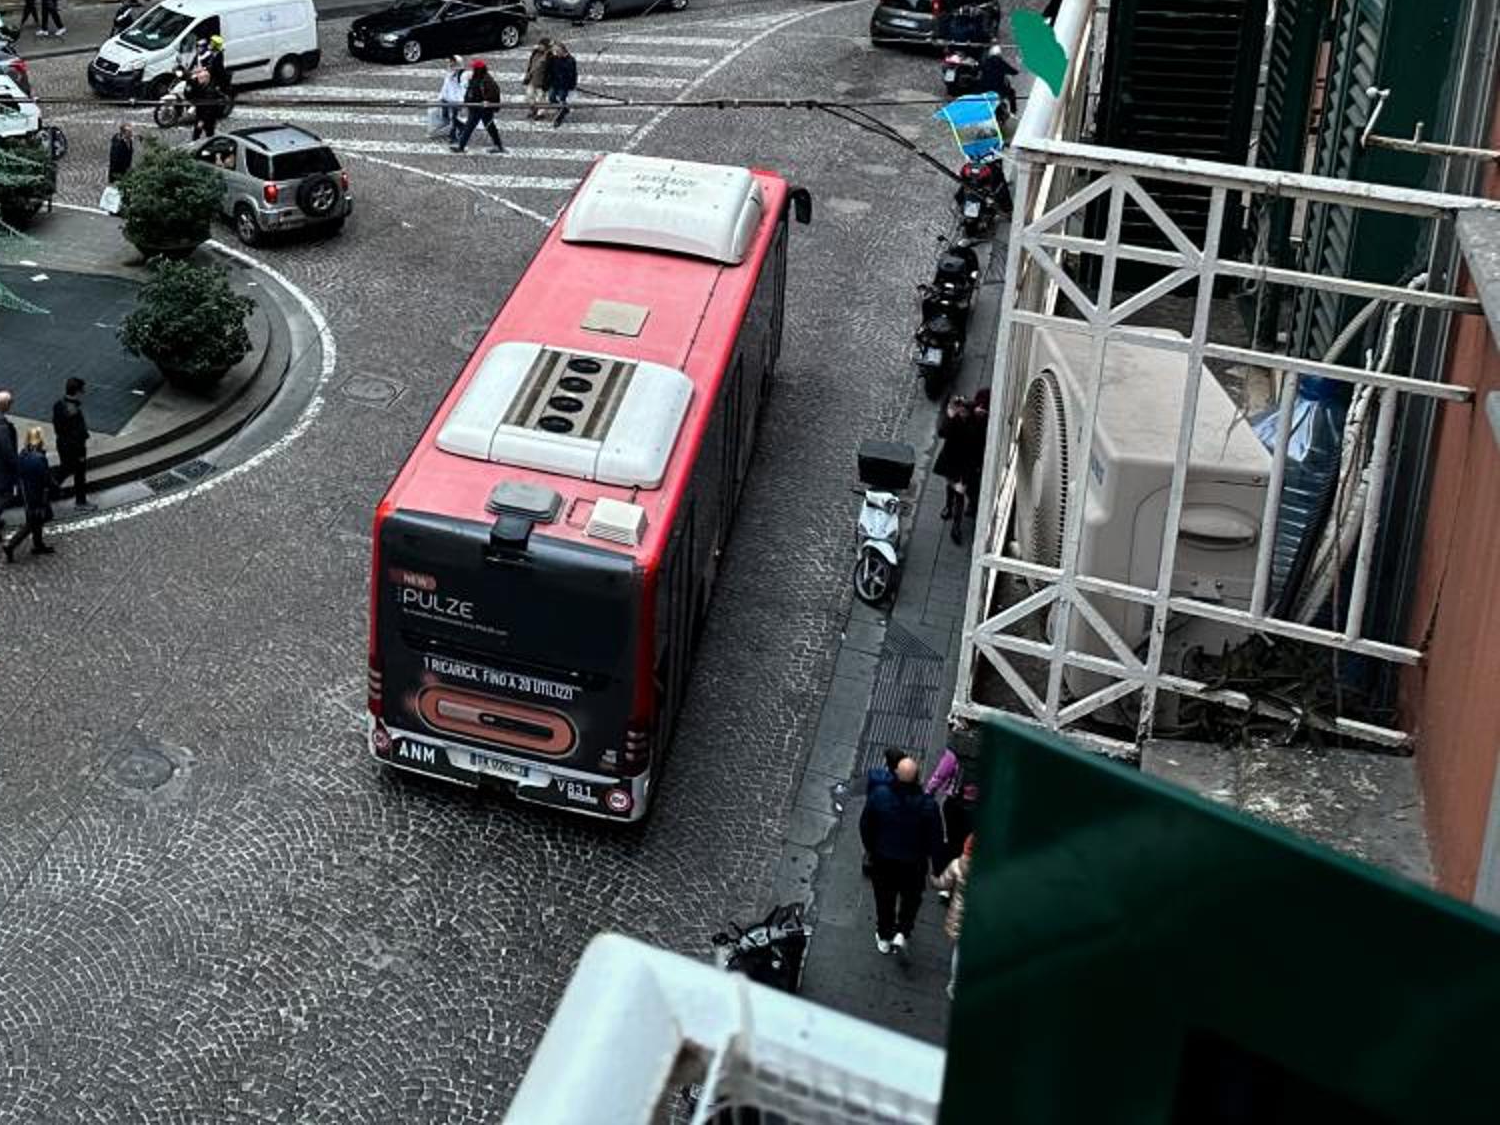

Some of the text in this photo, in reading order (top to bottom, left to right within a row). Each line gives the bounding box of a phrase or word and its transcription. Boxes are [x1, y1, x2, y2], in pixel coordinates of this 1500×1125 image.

[403, 588, 474, 619] PULZE
[482, 668, 508, 686] FINO
[508, 676, 516, 689] A
[399, 741, 436, 764] ANM
